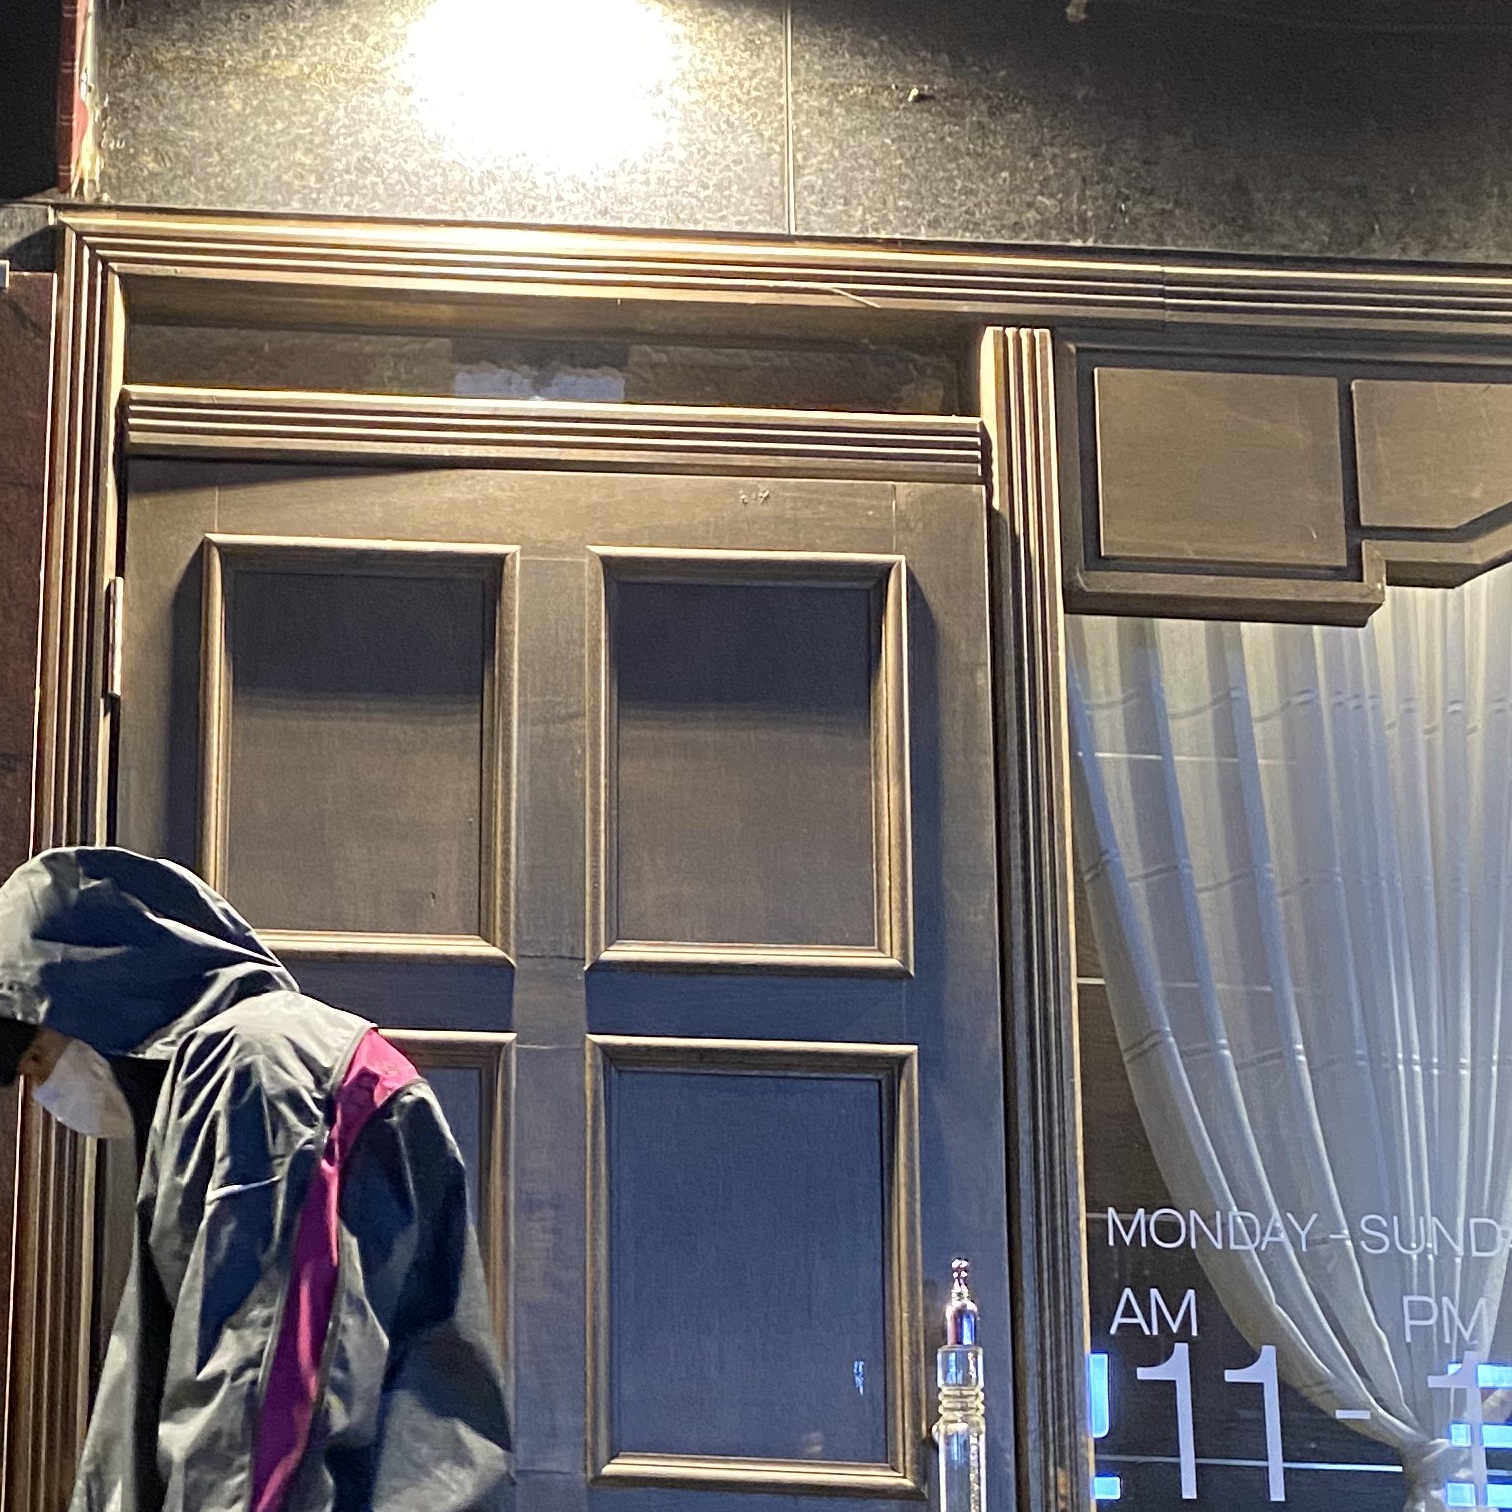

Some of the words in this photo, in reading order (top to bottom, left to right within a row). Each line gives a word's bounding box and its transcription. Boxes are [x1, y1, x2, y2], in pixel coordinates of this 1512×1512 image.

[1106, 1206, 1318, 1253] MONDAY
[1359, 1213, 1512, 1258] SUND
[1109, 1287, 1199, 1337] AM
[1402, 1295, 1488, 1345] PM
[1136, 1342, 1286, 1502] 11
